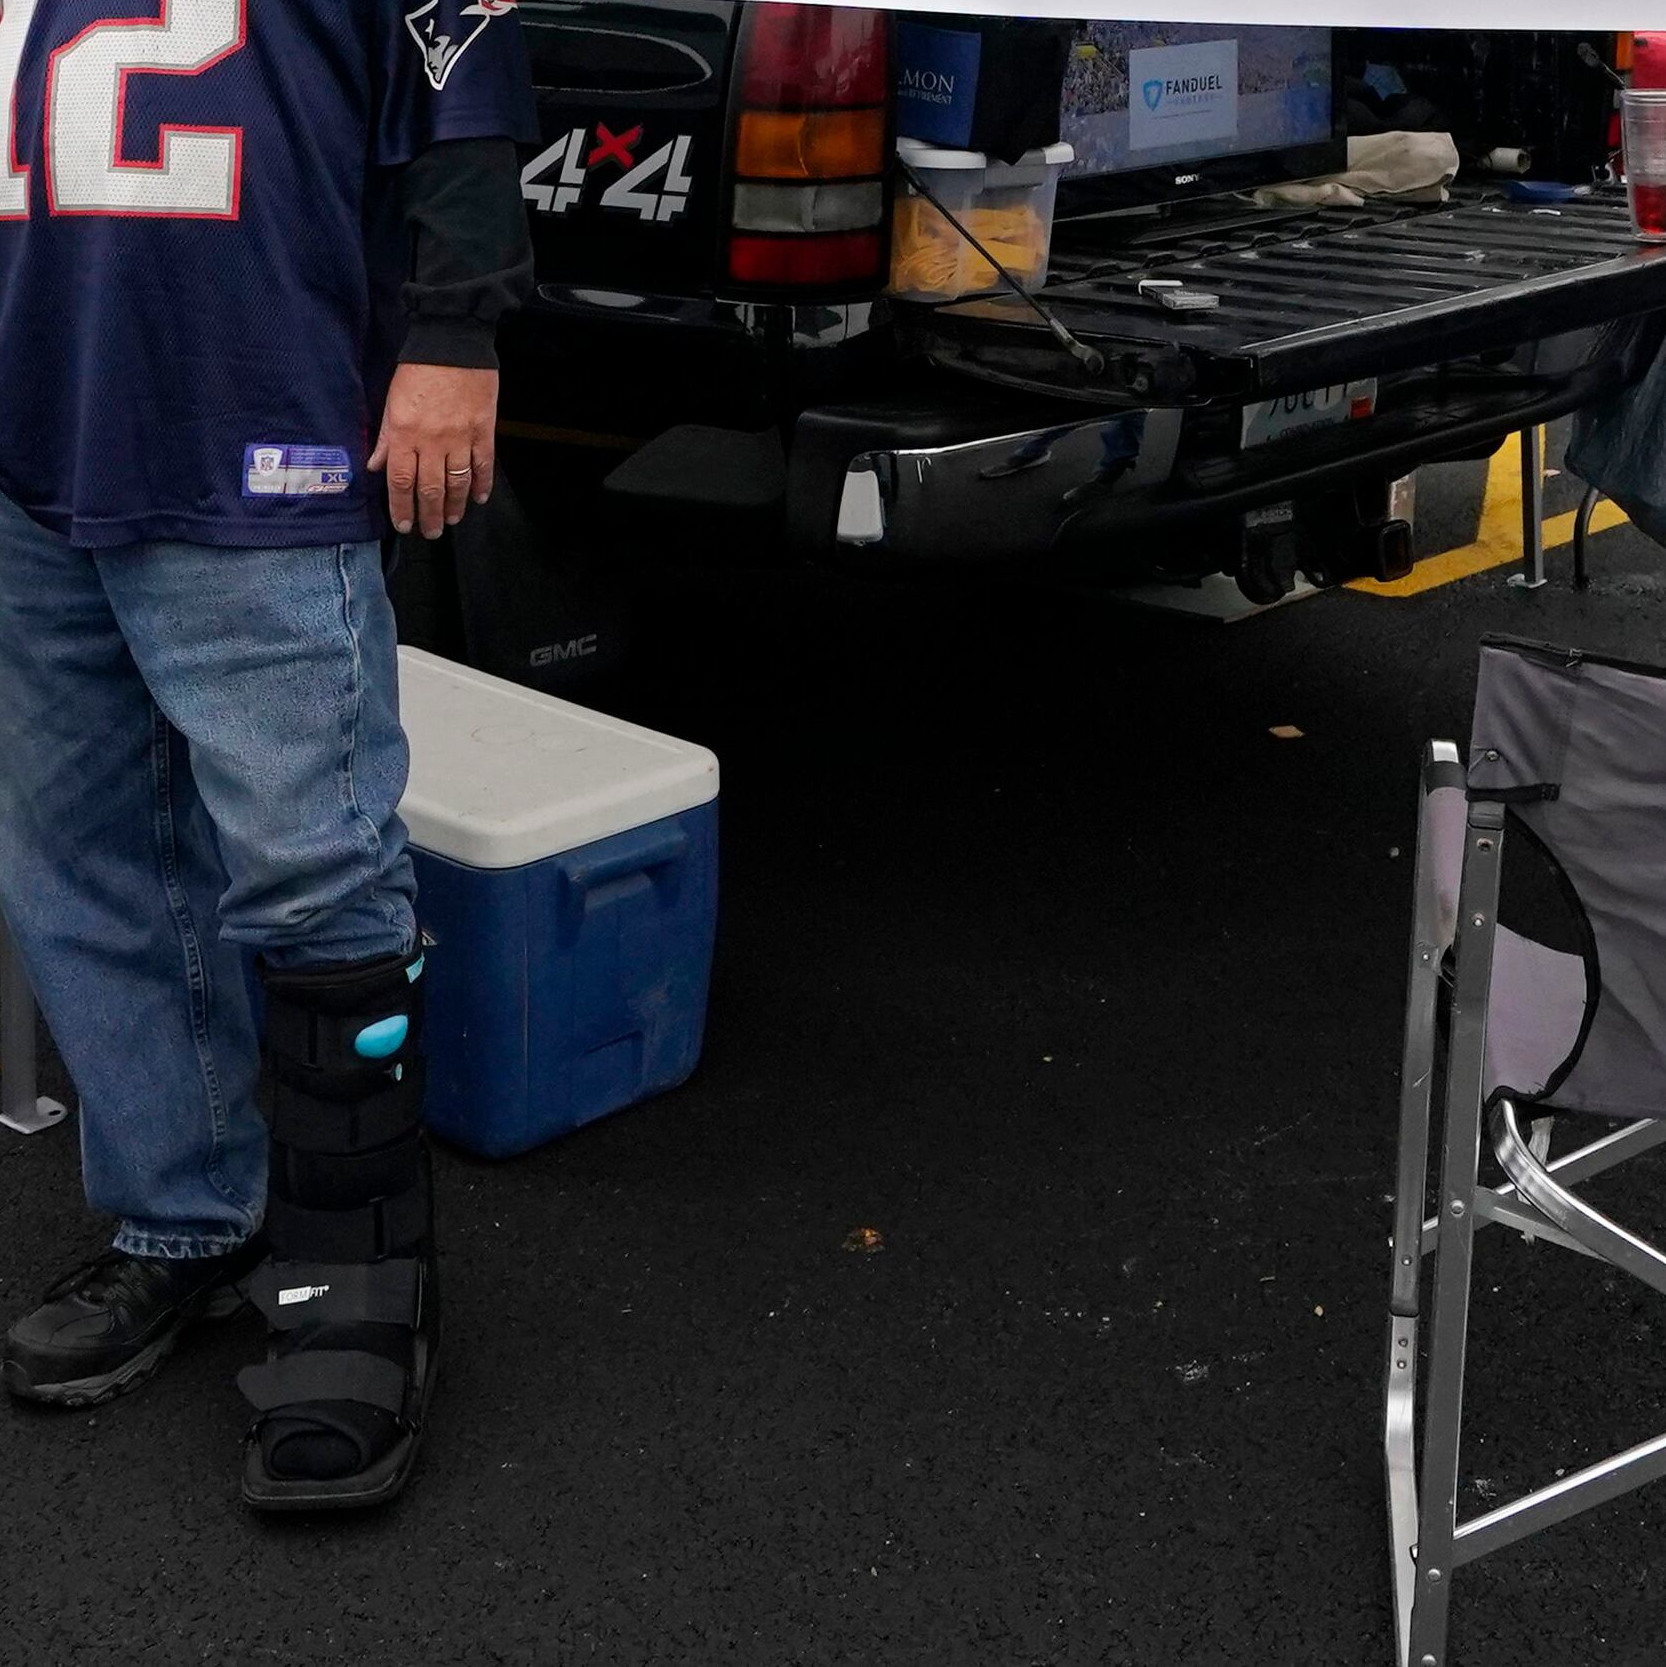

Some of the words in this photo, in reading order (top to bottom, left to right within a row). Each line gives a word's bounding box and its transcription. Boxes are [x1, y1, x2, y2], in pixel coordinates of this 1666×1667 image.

[1166, 75, 1223, 95] FANDUEL
[1175, 173, 1200, 185] SONY
[327, 472, 348, 482] XL
[530, 634, 597, 667] GMC
